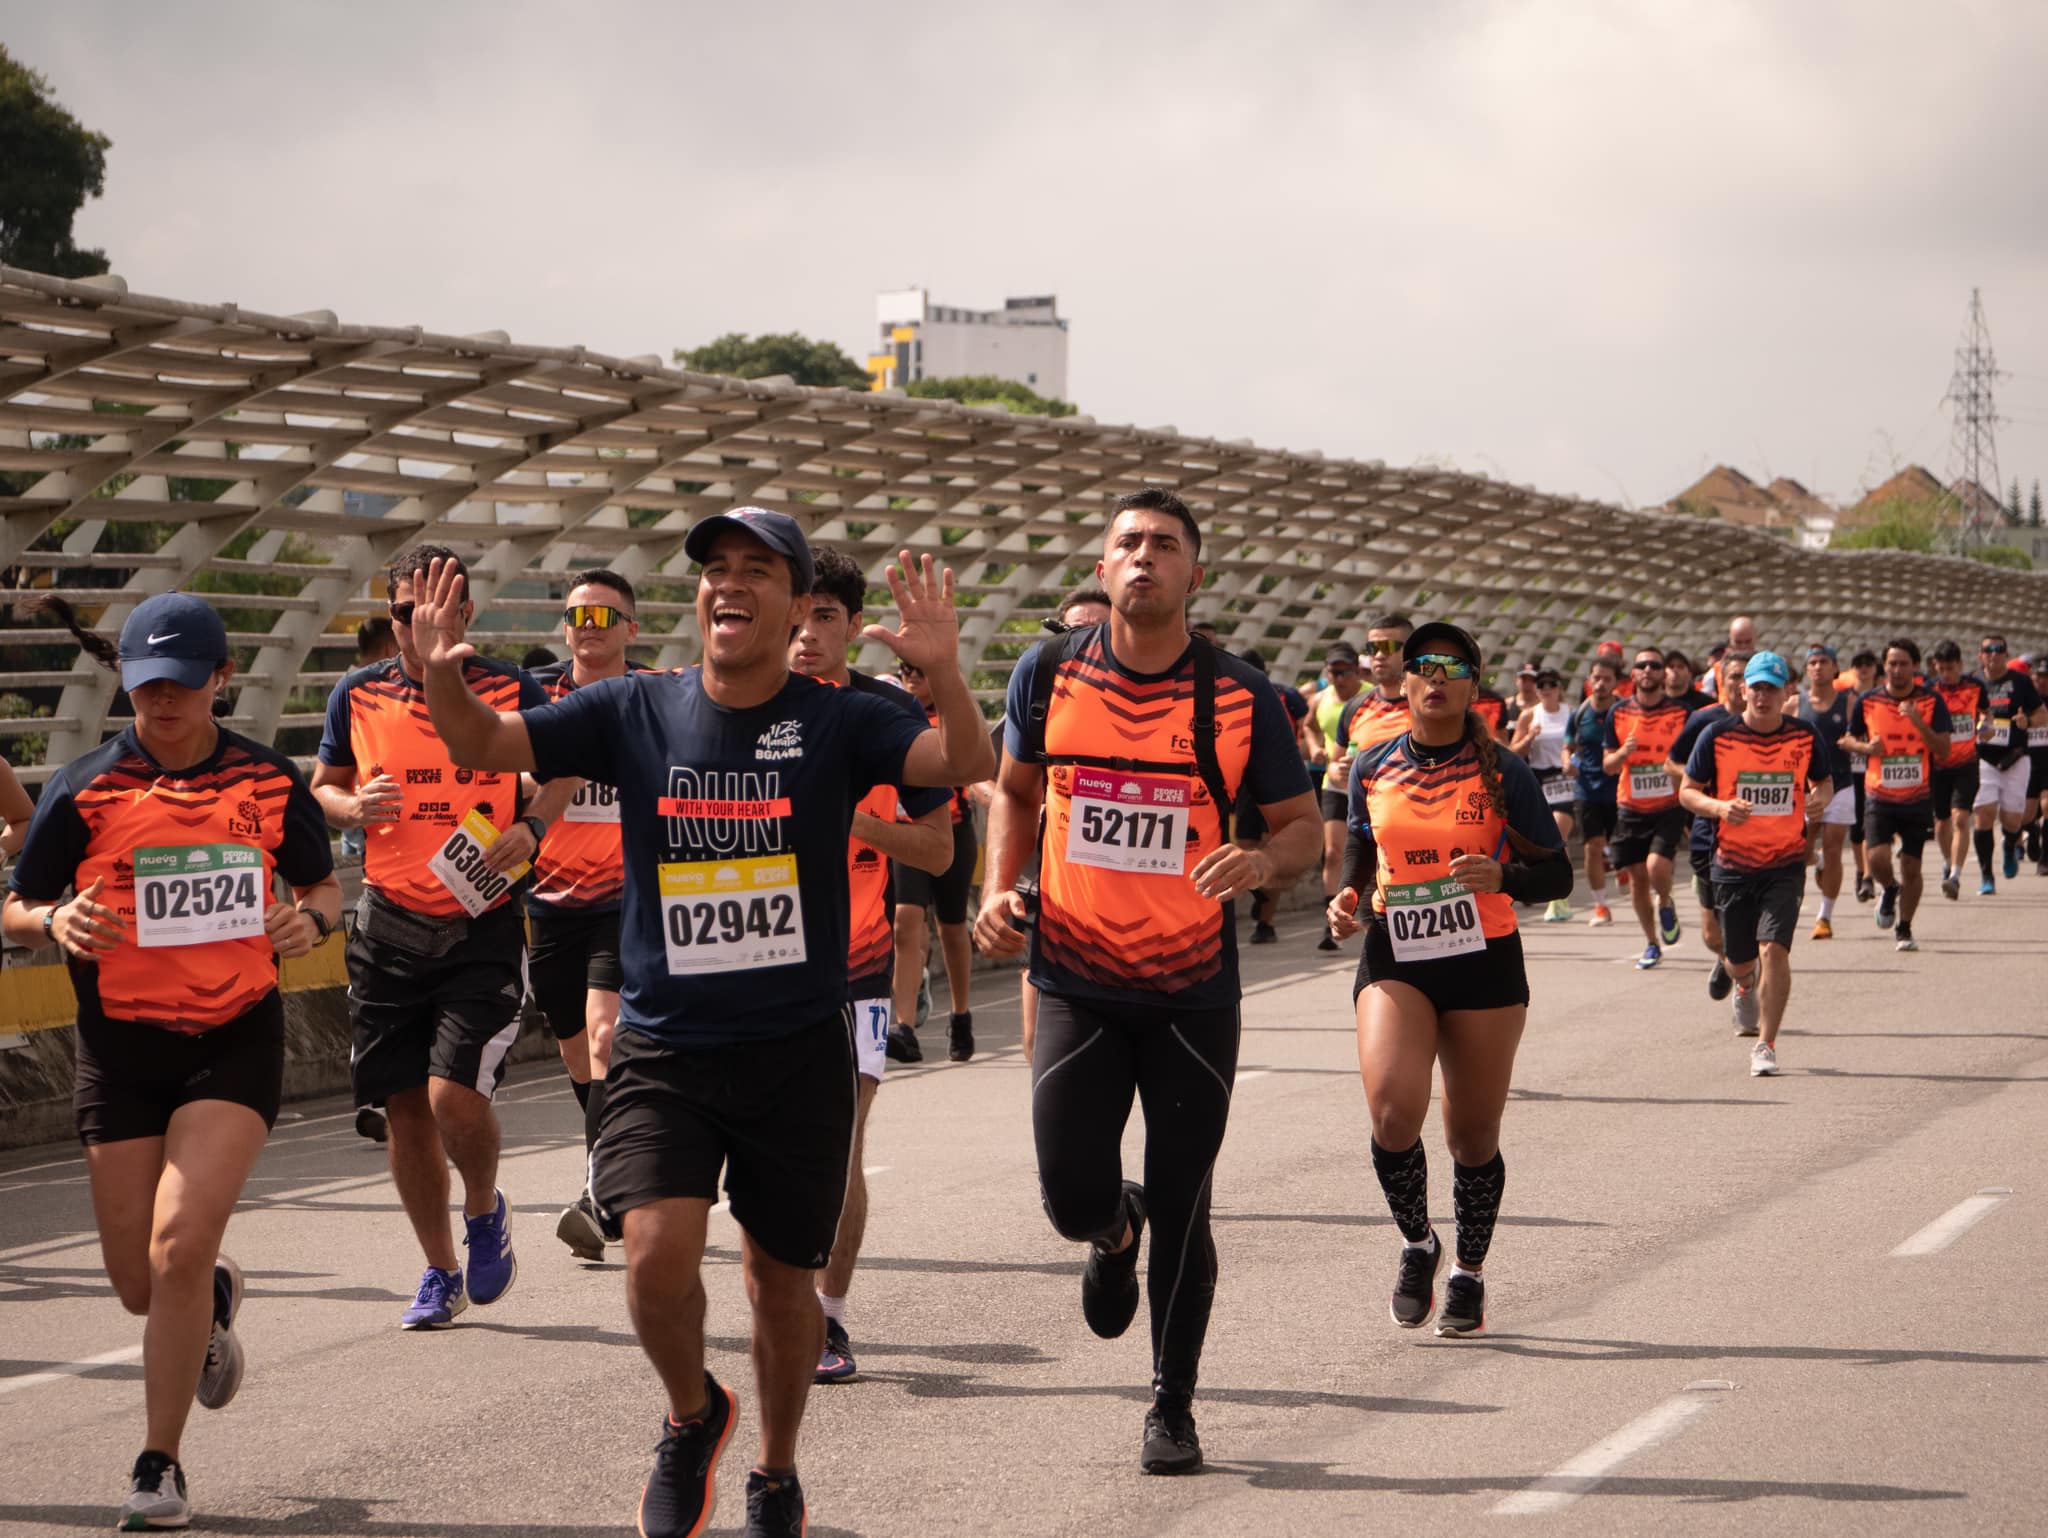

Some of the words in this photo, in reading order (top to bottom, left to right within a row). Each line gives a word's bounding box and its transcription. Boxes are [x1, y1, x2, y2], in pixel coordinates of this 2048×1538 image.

[406, 768, 442, 777] PEOPLE
[407, 775, 442, 784] PLAYS
[1883, 766, 1920, 780] 01235
[1153, 787, 1185, 797] PEOPLE
[1153, 793, 1184, 803] PLAYS
[1742, 787, 1789, 805] 01987
[668, 766, 782, 853] RUN
[675, 801, 702, 815] WITH
[705, 802, 734, 816] YOUR
[737, 802, 772, 817] HEART
[1082, 804, 1174, 850] 52171
[443, 833, 508, 902] 03080
[144, 872, 257, 920] 02524
[668, 894, 797, 947] 02942
[1392, 900, 1476, 941] 02240
